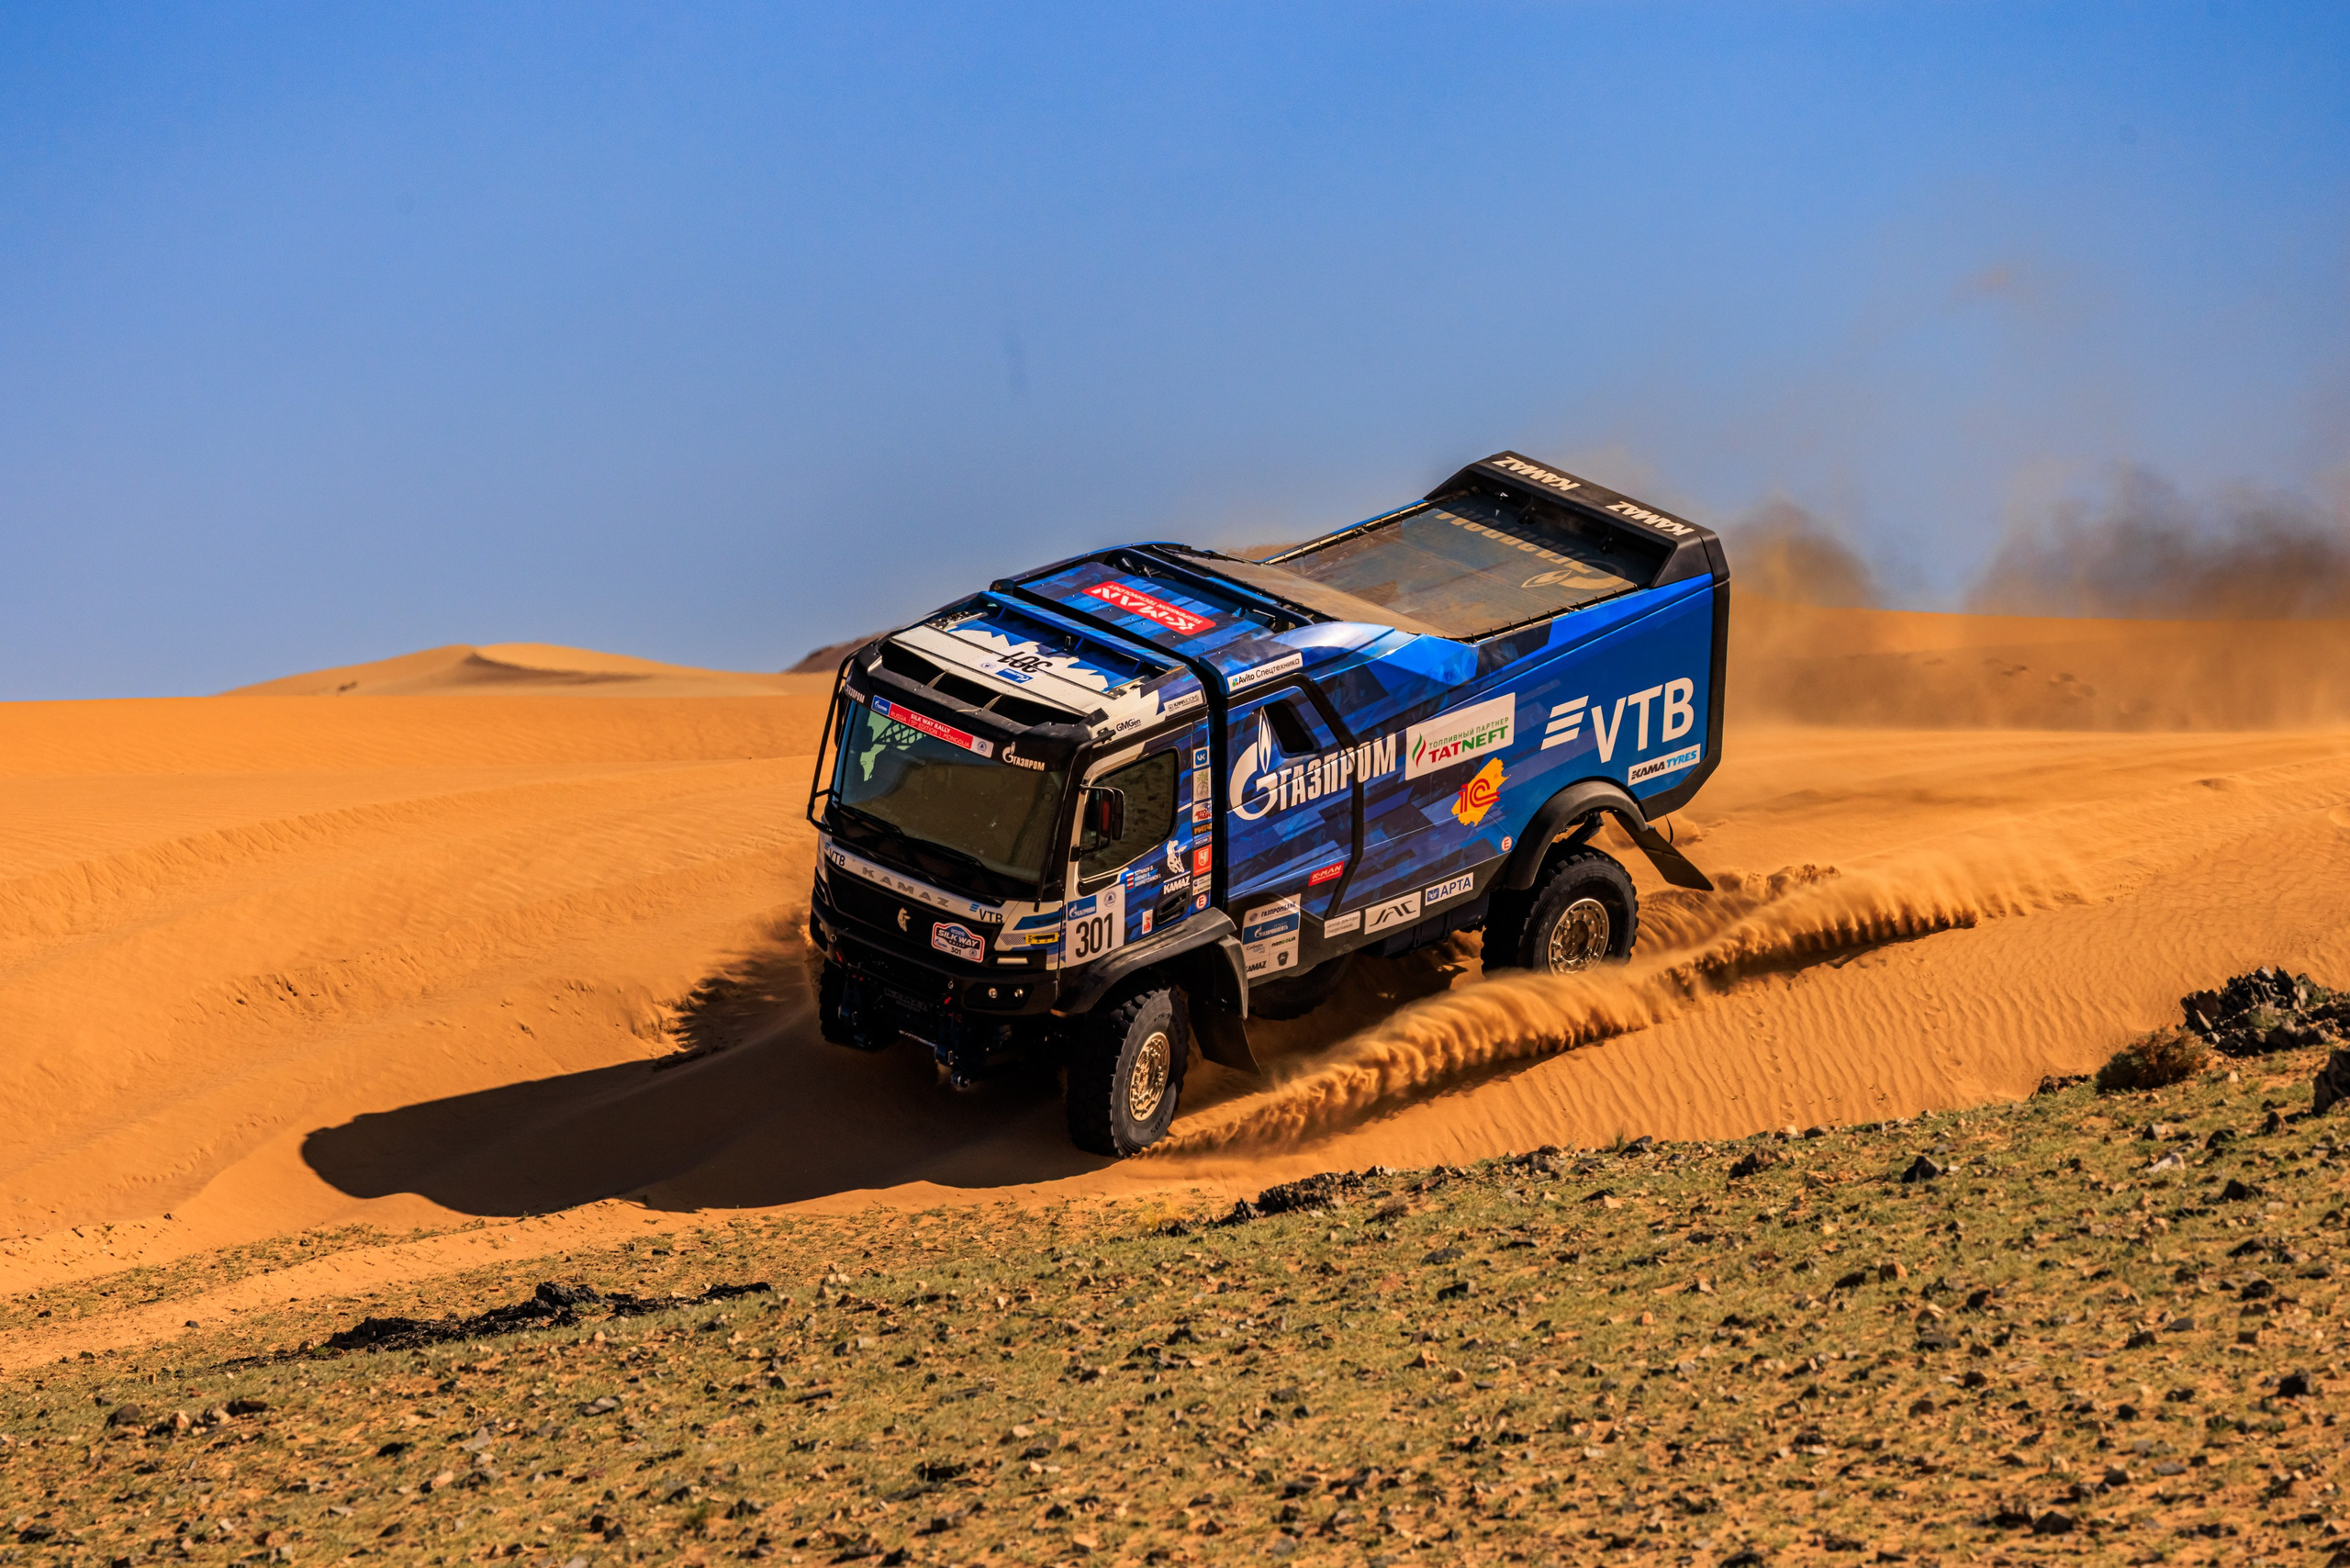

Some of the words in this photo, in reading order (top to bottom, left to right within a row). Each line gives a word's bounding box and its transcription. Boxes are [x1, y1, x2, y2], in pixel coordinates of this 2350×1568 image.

[1492, 456, 1581, 491] KAMAZ
[1605, 500, 1695, 536] KAMAZ
[1106, 585, 1158, 606] TECHNOLOGY
[1156, 604, 1203, 624] SUSPENSION
[997, 651, 1053, 673] 301
[1238, 670, 1255, 685] Avito
[1256, 657, 1300, 678] Спецтехника
[890, 711, 907, 722] RUSSIA
[918, 722, 937, 735] EDITION
[943, 734, 970, 747] MONGOLIA
[911, 713, 922, 722] SILK
[922, 718, 934, 727] WAY
[934, 723, 951, 734] RALLY
[1116, 719, 1141, 732] GMGen
[1591, 677, 1695, 764] VTB
[1428, 727, 1474, 749] ТОПЛИВНЫЙ
[1475, 716, 1509, 734] ПАРТНЕР
[1428, 724, 1508, 763] TATNEFT
[1013, 755, 1045, 771] ГАЗПРОМ
[1197, 753, 1205, 761] VK
[1631, 761, 1665, 780] KAMA
[1666, 749, 1697, 768] TYRES
[1280, 733, 1397, 812] ГАЗПРОМ
[828, 848, 845, 867] VTB
[862, 867, 949, 908] KAMAZ
[1163, 876, 1191, 895] KAMAZ
[979, 909, 1003, 924] VTB
[937, 929, 958, 942] SILK
[958, 935, 979, 947] WAY
[1076, 913, 1113, 958] 301
[950, 946, 962, 955] 301
